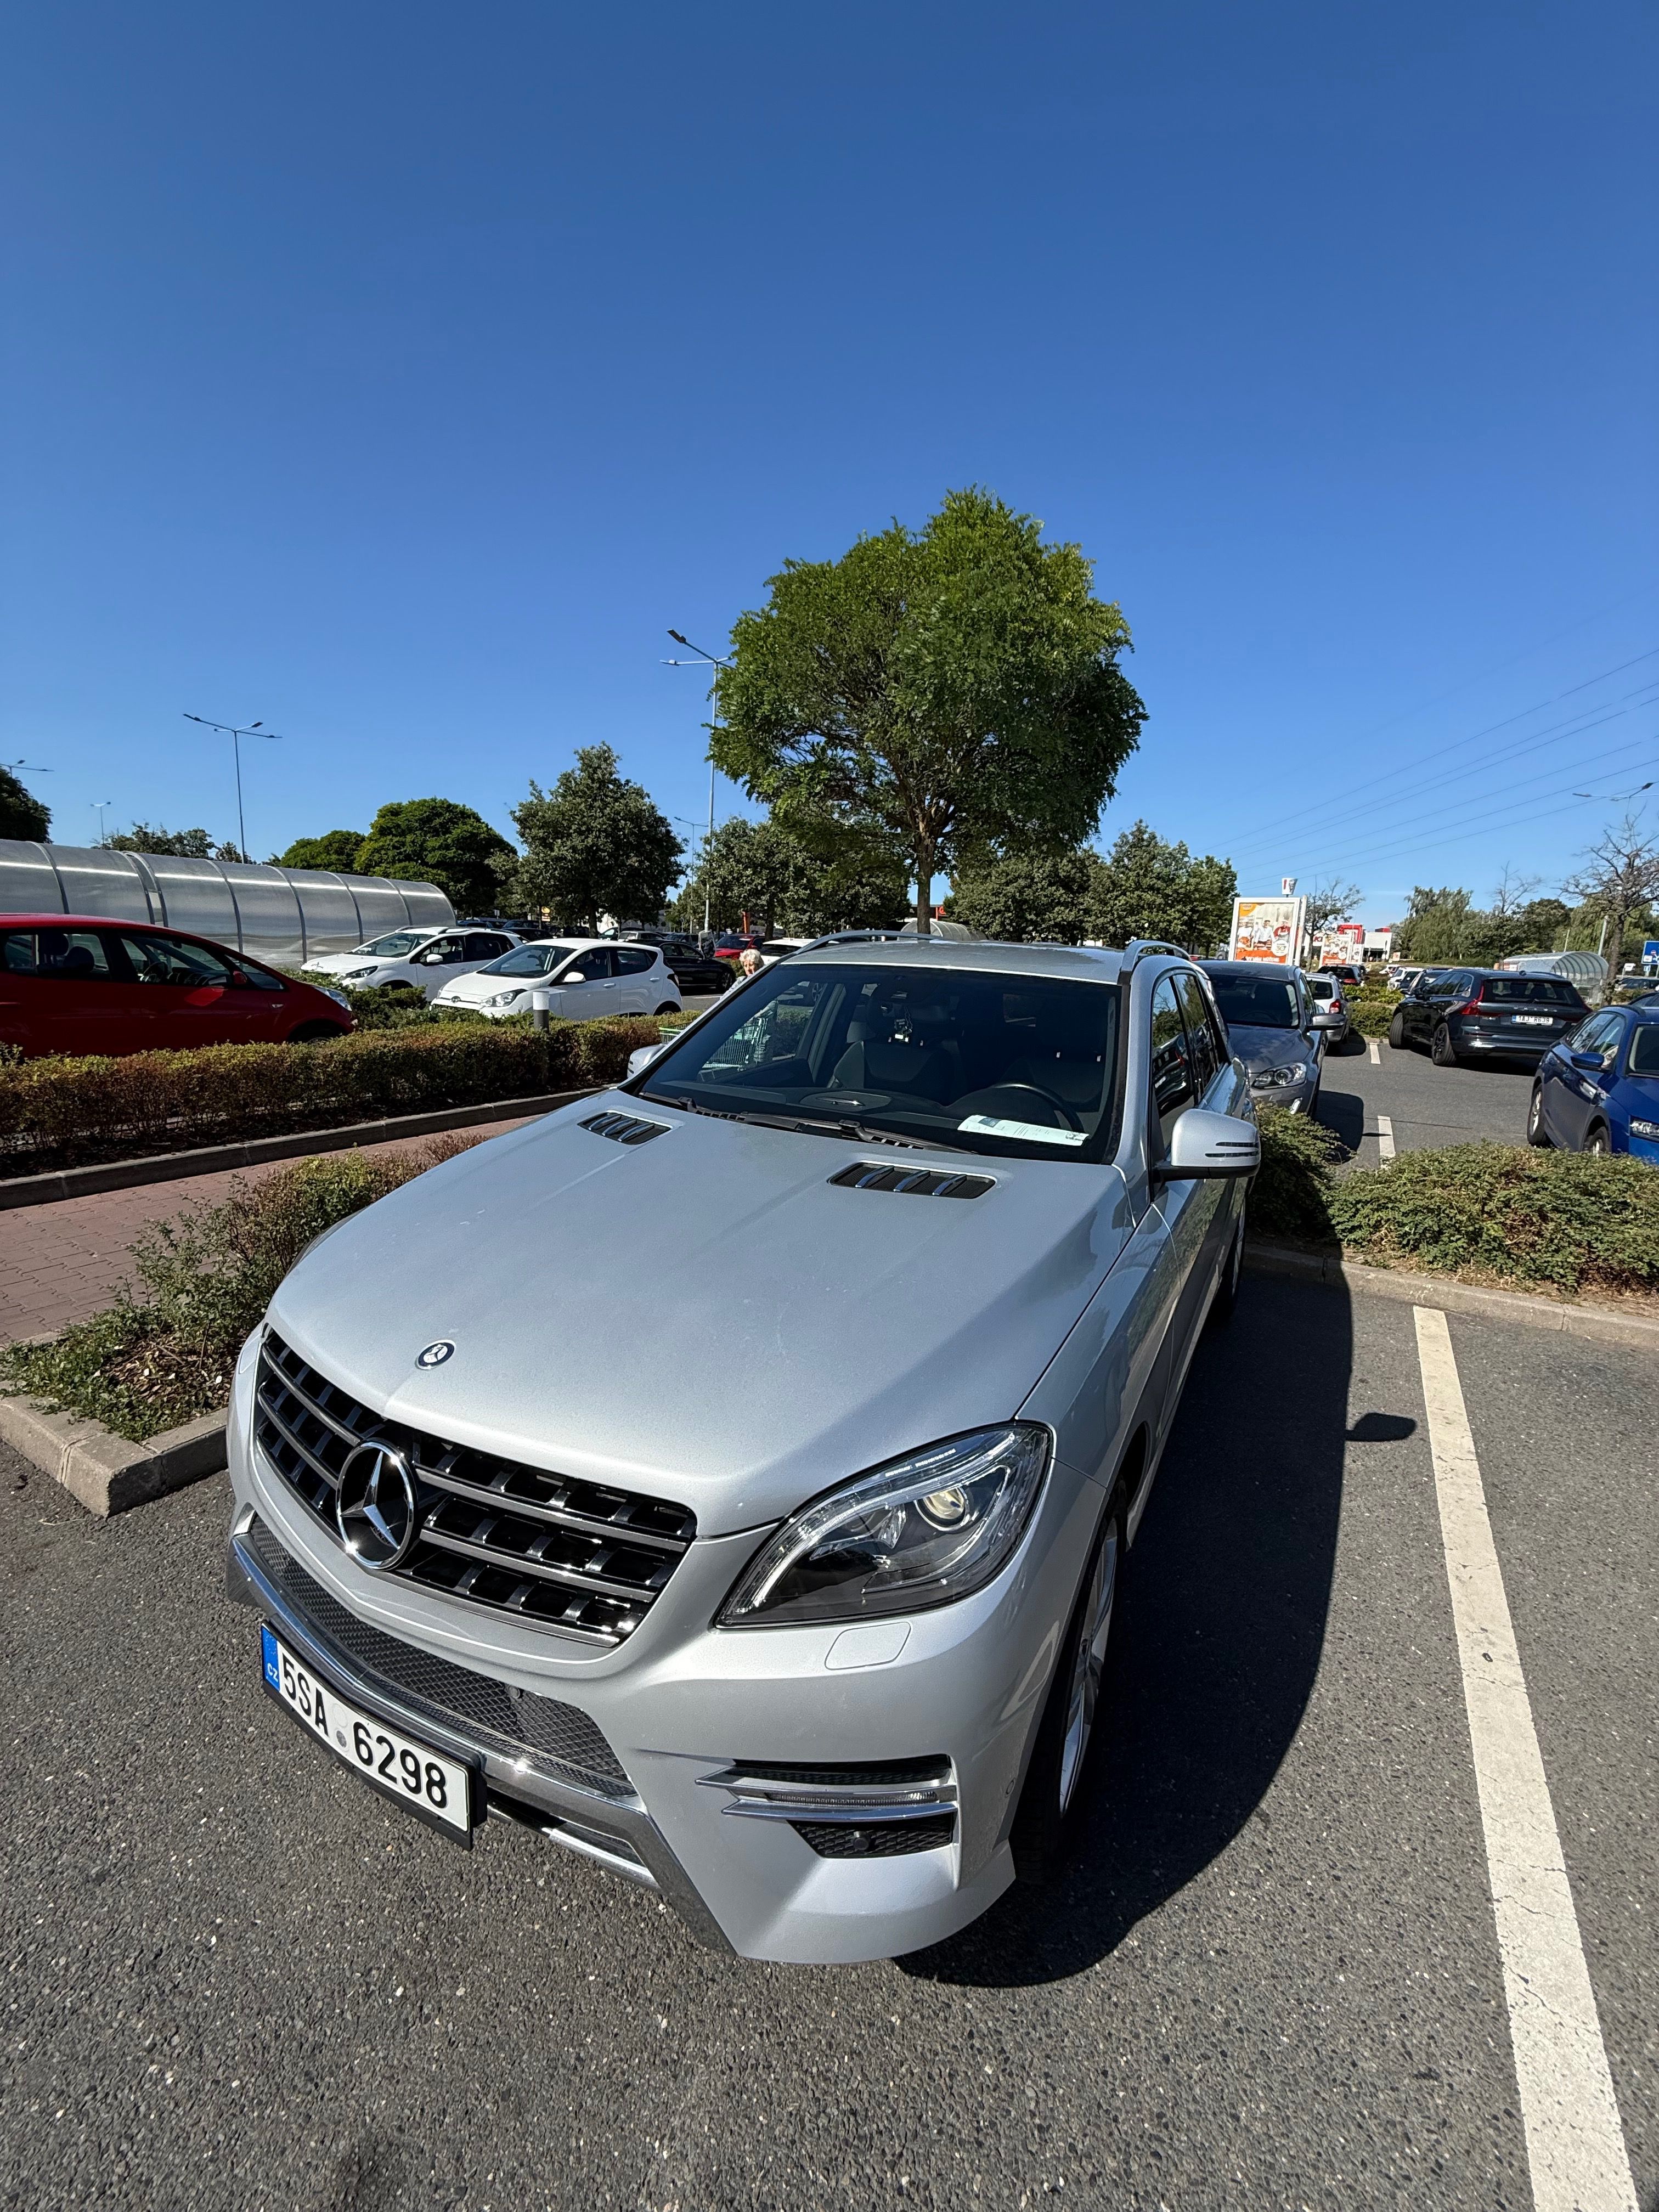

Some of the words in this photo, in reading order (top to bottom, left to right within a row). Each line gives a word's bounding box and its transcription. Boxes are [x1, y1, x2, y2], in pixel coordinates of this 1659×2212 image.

[267, 1662, 279, 1683] CZ
[281, 1655, 329, 1737] 5SA
[353, 1721, 448, 1809] 6298
